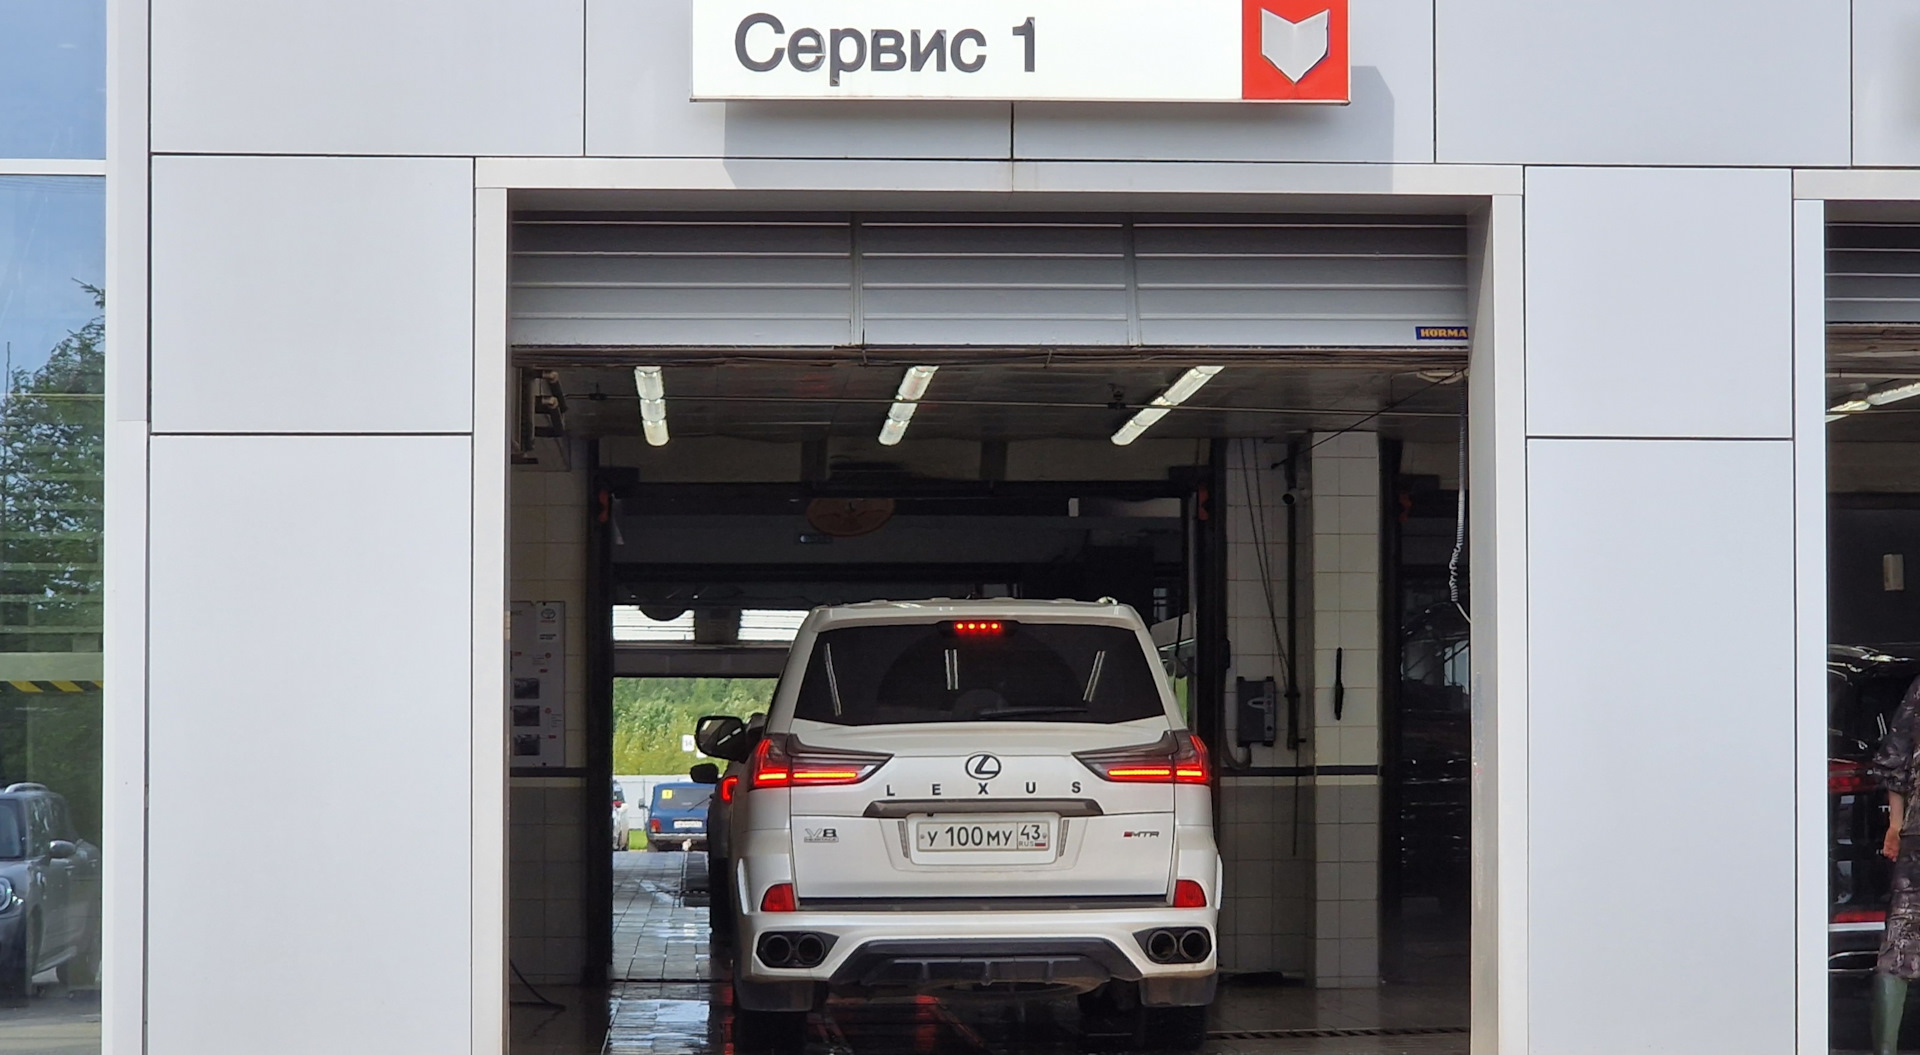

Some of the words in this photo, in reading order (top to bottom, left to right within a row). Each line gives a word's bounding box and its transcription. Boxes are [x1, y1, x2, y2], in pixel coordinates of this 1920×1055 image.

[735, 13, 987, 87] Сервис
[1012, 16, 1035, 73] 1
[886, 781, 1081, 797] LEXUS
[804, 827, 837, 838] V8
[1020, 824, 1041, 841] 43
